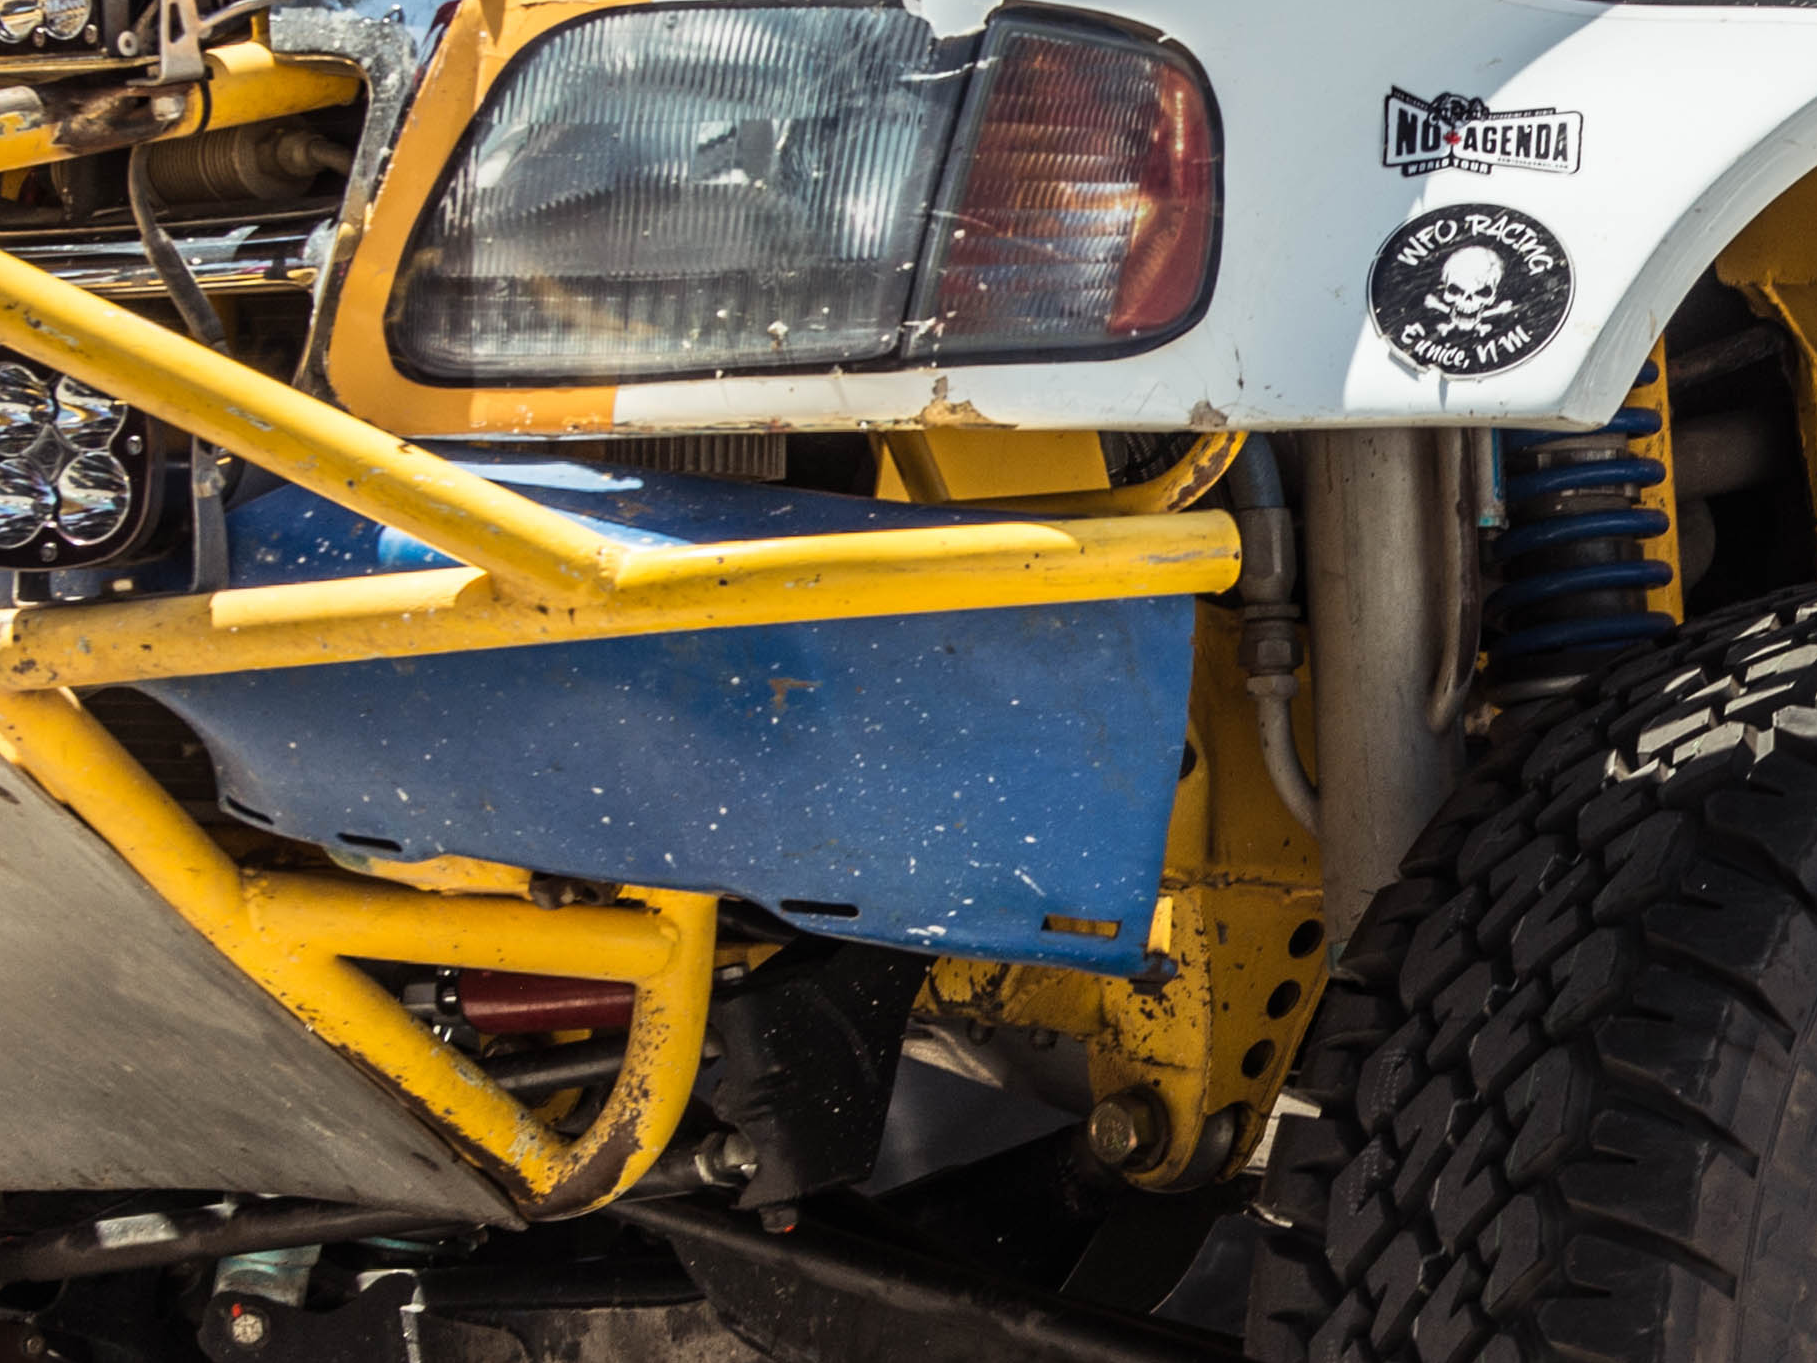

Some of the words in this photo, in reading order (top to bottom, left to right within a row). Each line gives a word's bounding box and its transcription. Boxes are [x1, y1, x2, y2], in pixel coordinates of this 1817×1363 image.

[1462, 121, 1569, 163] AGENDA
[1407, 156, 1450, 176] WORLD
[1452, 158, 1489, 175] TOUR
[1396, 219, 1458, 267] WFO
[1463, 213, 1555, 277] RACING
[1400, 322, 1471, 369] Eunice,
